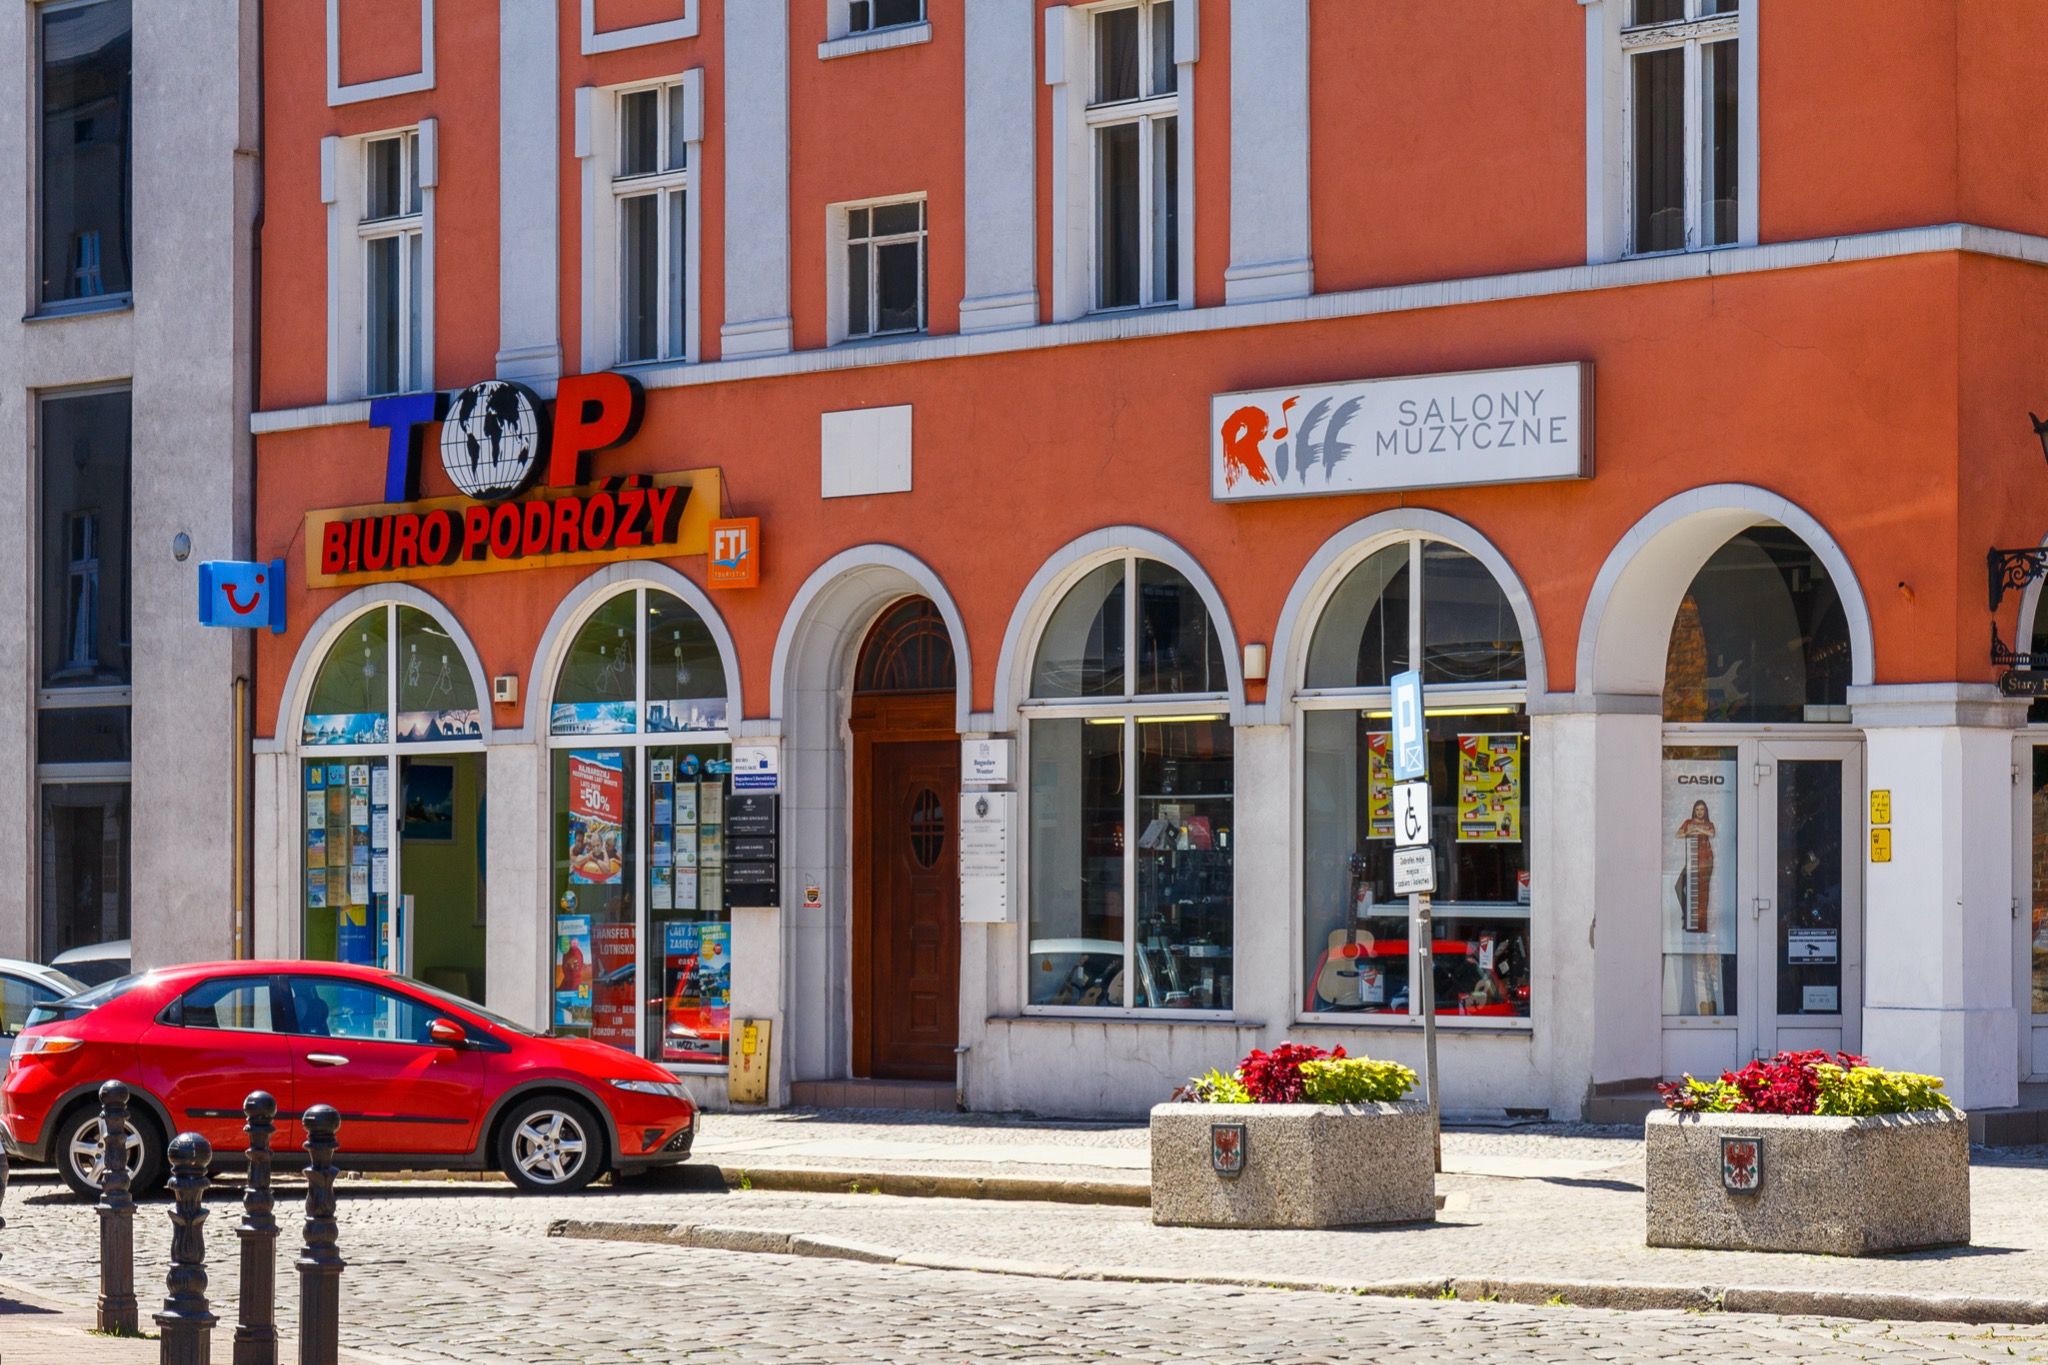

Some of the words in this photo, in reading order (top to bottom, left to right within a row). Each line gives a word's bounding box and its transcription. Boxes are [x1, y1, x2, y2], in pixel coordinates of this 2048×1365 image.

[1399, 388, 1545, 427] SALONY
[1376, 415, 1568, 456] MUZYCZNE
[1221, 395, 1366, 494] Riff
[321, 509, 458, 576] BIURO
[462, 474, 688, 561] PODRÓŻY
[715, 529, 747, 560] FTI
[2008, 677, 2039, 694] Stary
[1677, 775, 1725, 785] CASIO
[592, 927, 630, 939] TRANSFER
[669, 925, 686, 936] CAŁY
[687, 924, 699, 936] ŚW
[600, 943, 635, 956] LOTNISKO
[670, 939, 699, 952] ZASIĘGU
[678, 957, 700, 967] easyJ
[677, 971, 700, 980] RYANA
[622, 1005, 636, 1014] BERL
[612, 1016, 624, 1025] LUB
[593, 1026, 616, 1036] GORZÓW
